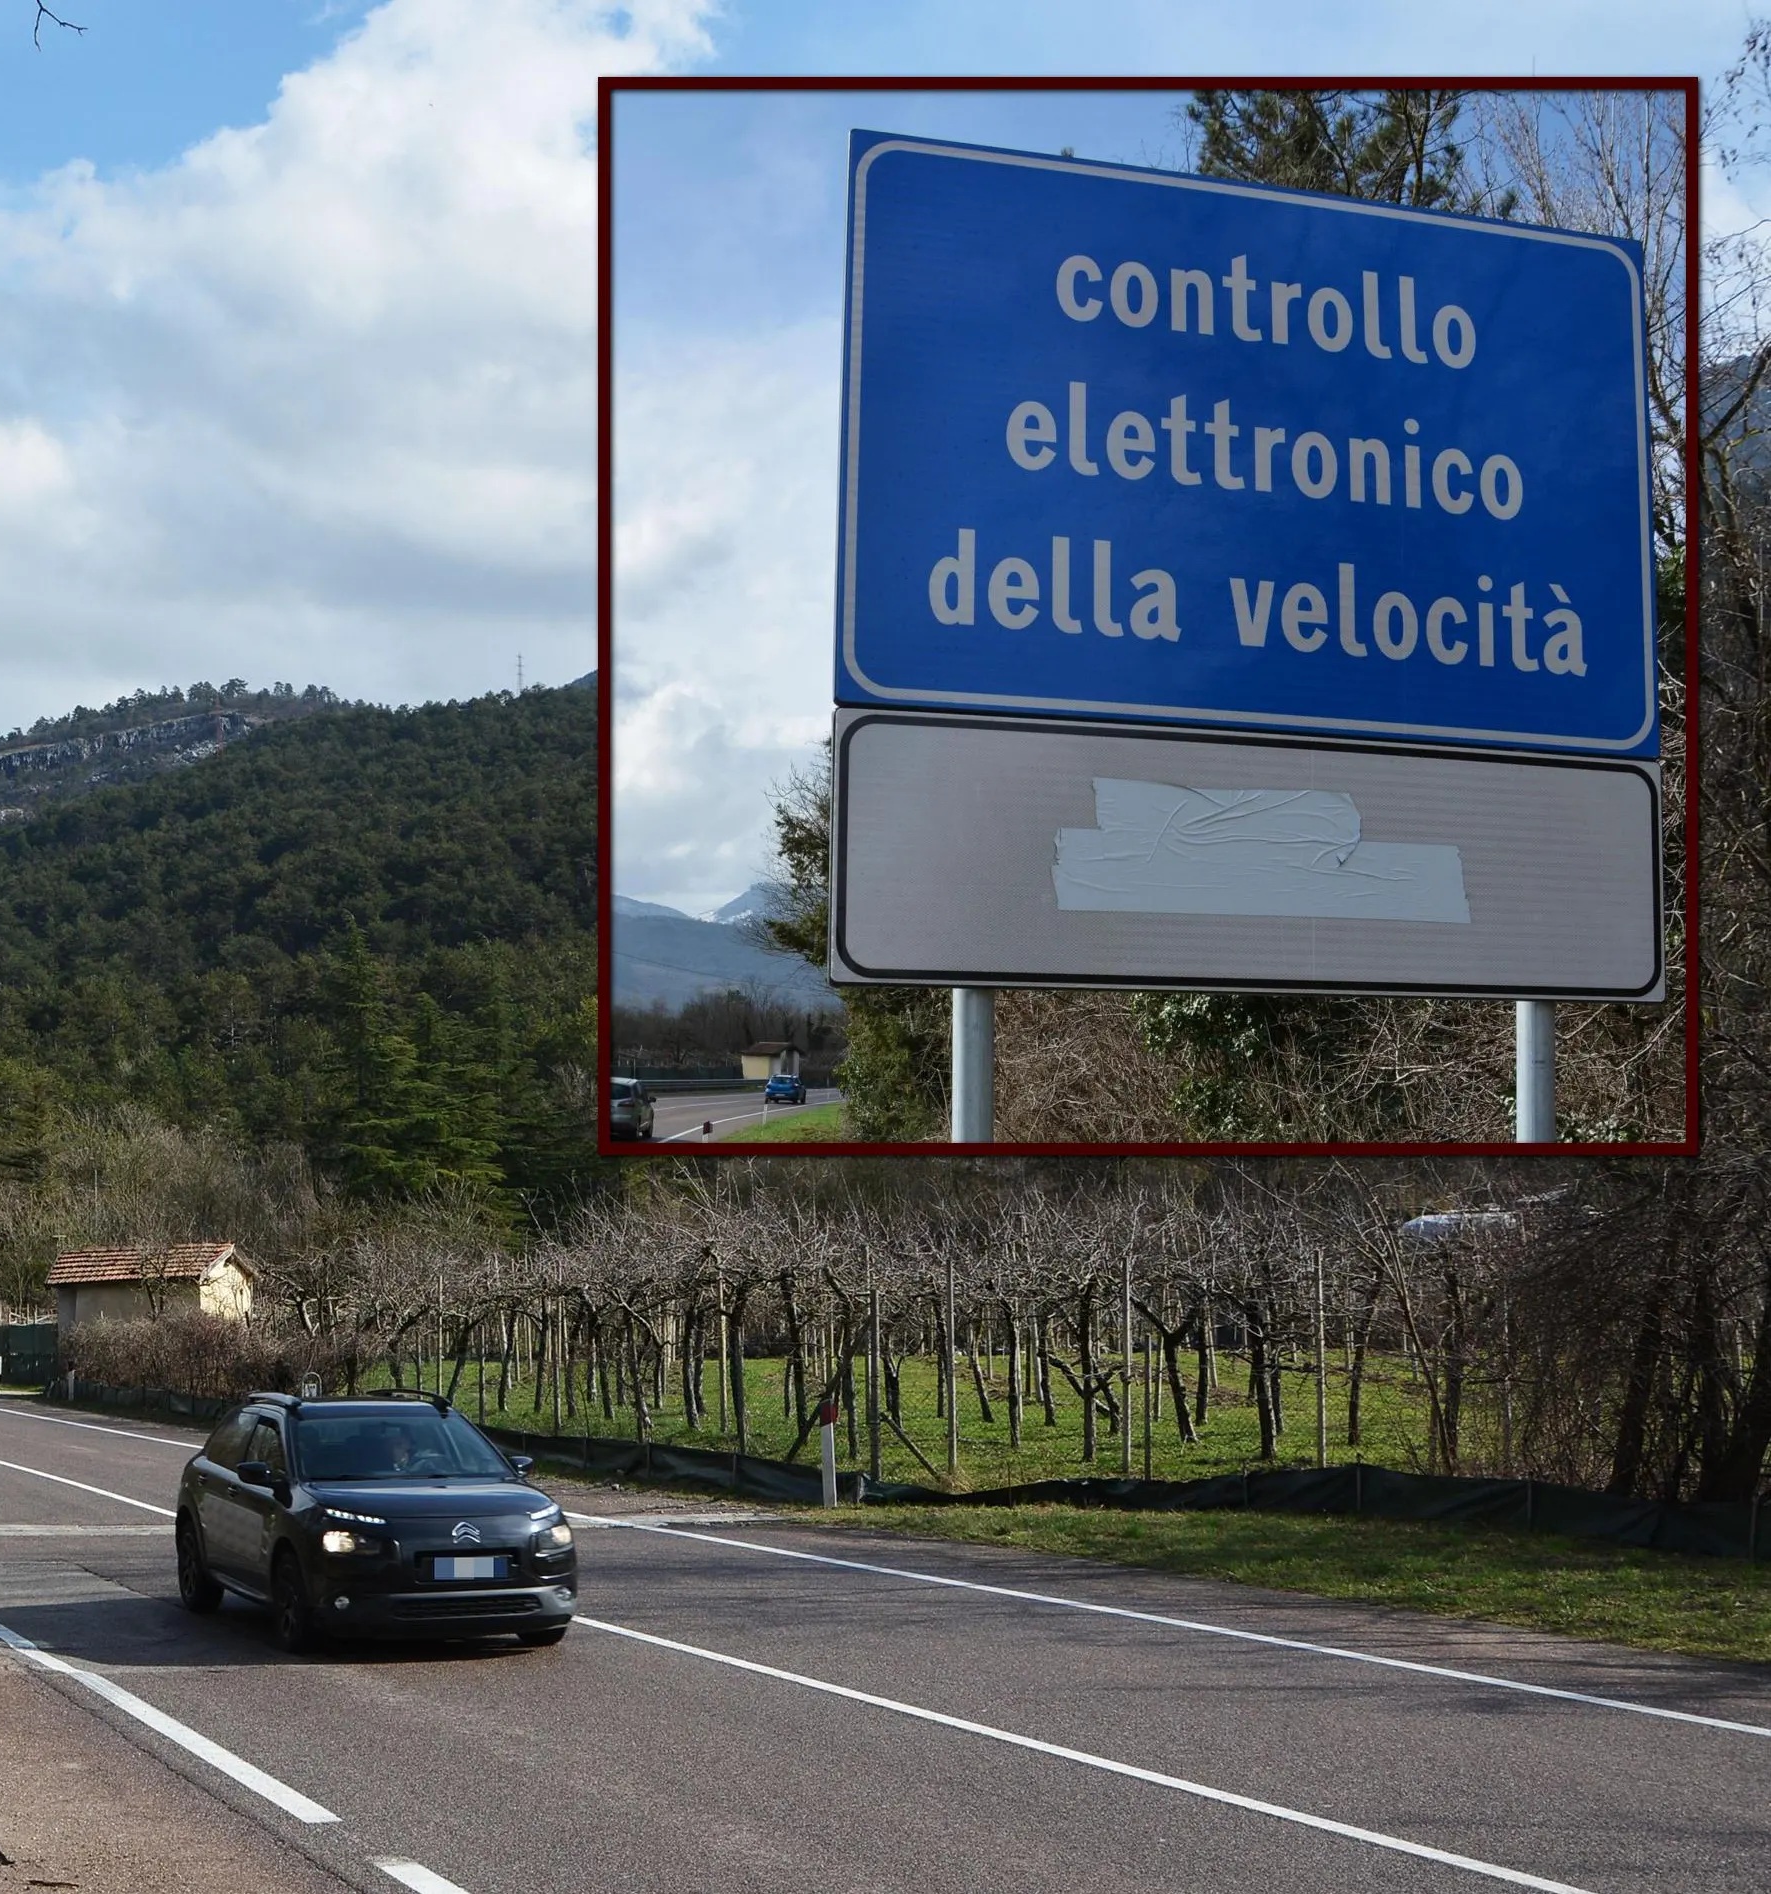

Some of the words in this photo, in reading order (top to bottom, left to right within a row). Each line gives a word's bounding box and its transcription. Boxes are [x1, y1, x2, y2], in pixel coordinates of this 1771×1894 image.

[1055, 252, 1478, 370] controllo
[1005, 380, 1524, 521] elettronico
[928, 527, 1181, 642] della
[1229, 562, 1588, 678] velocità
